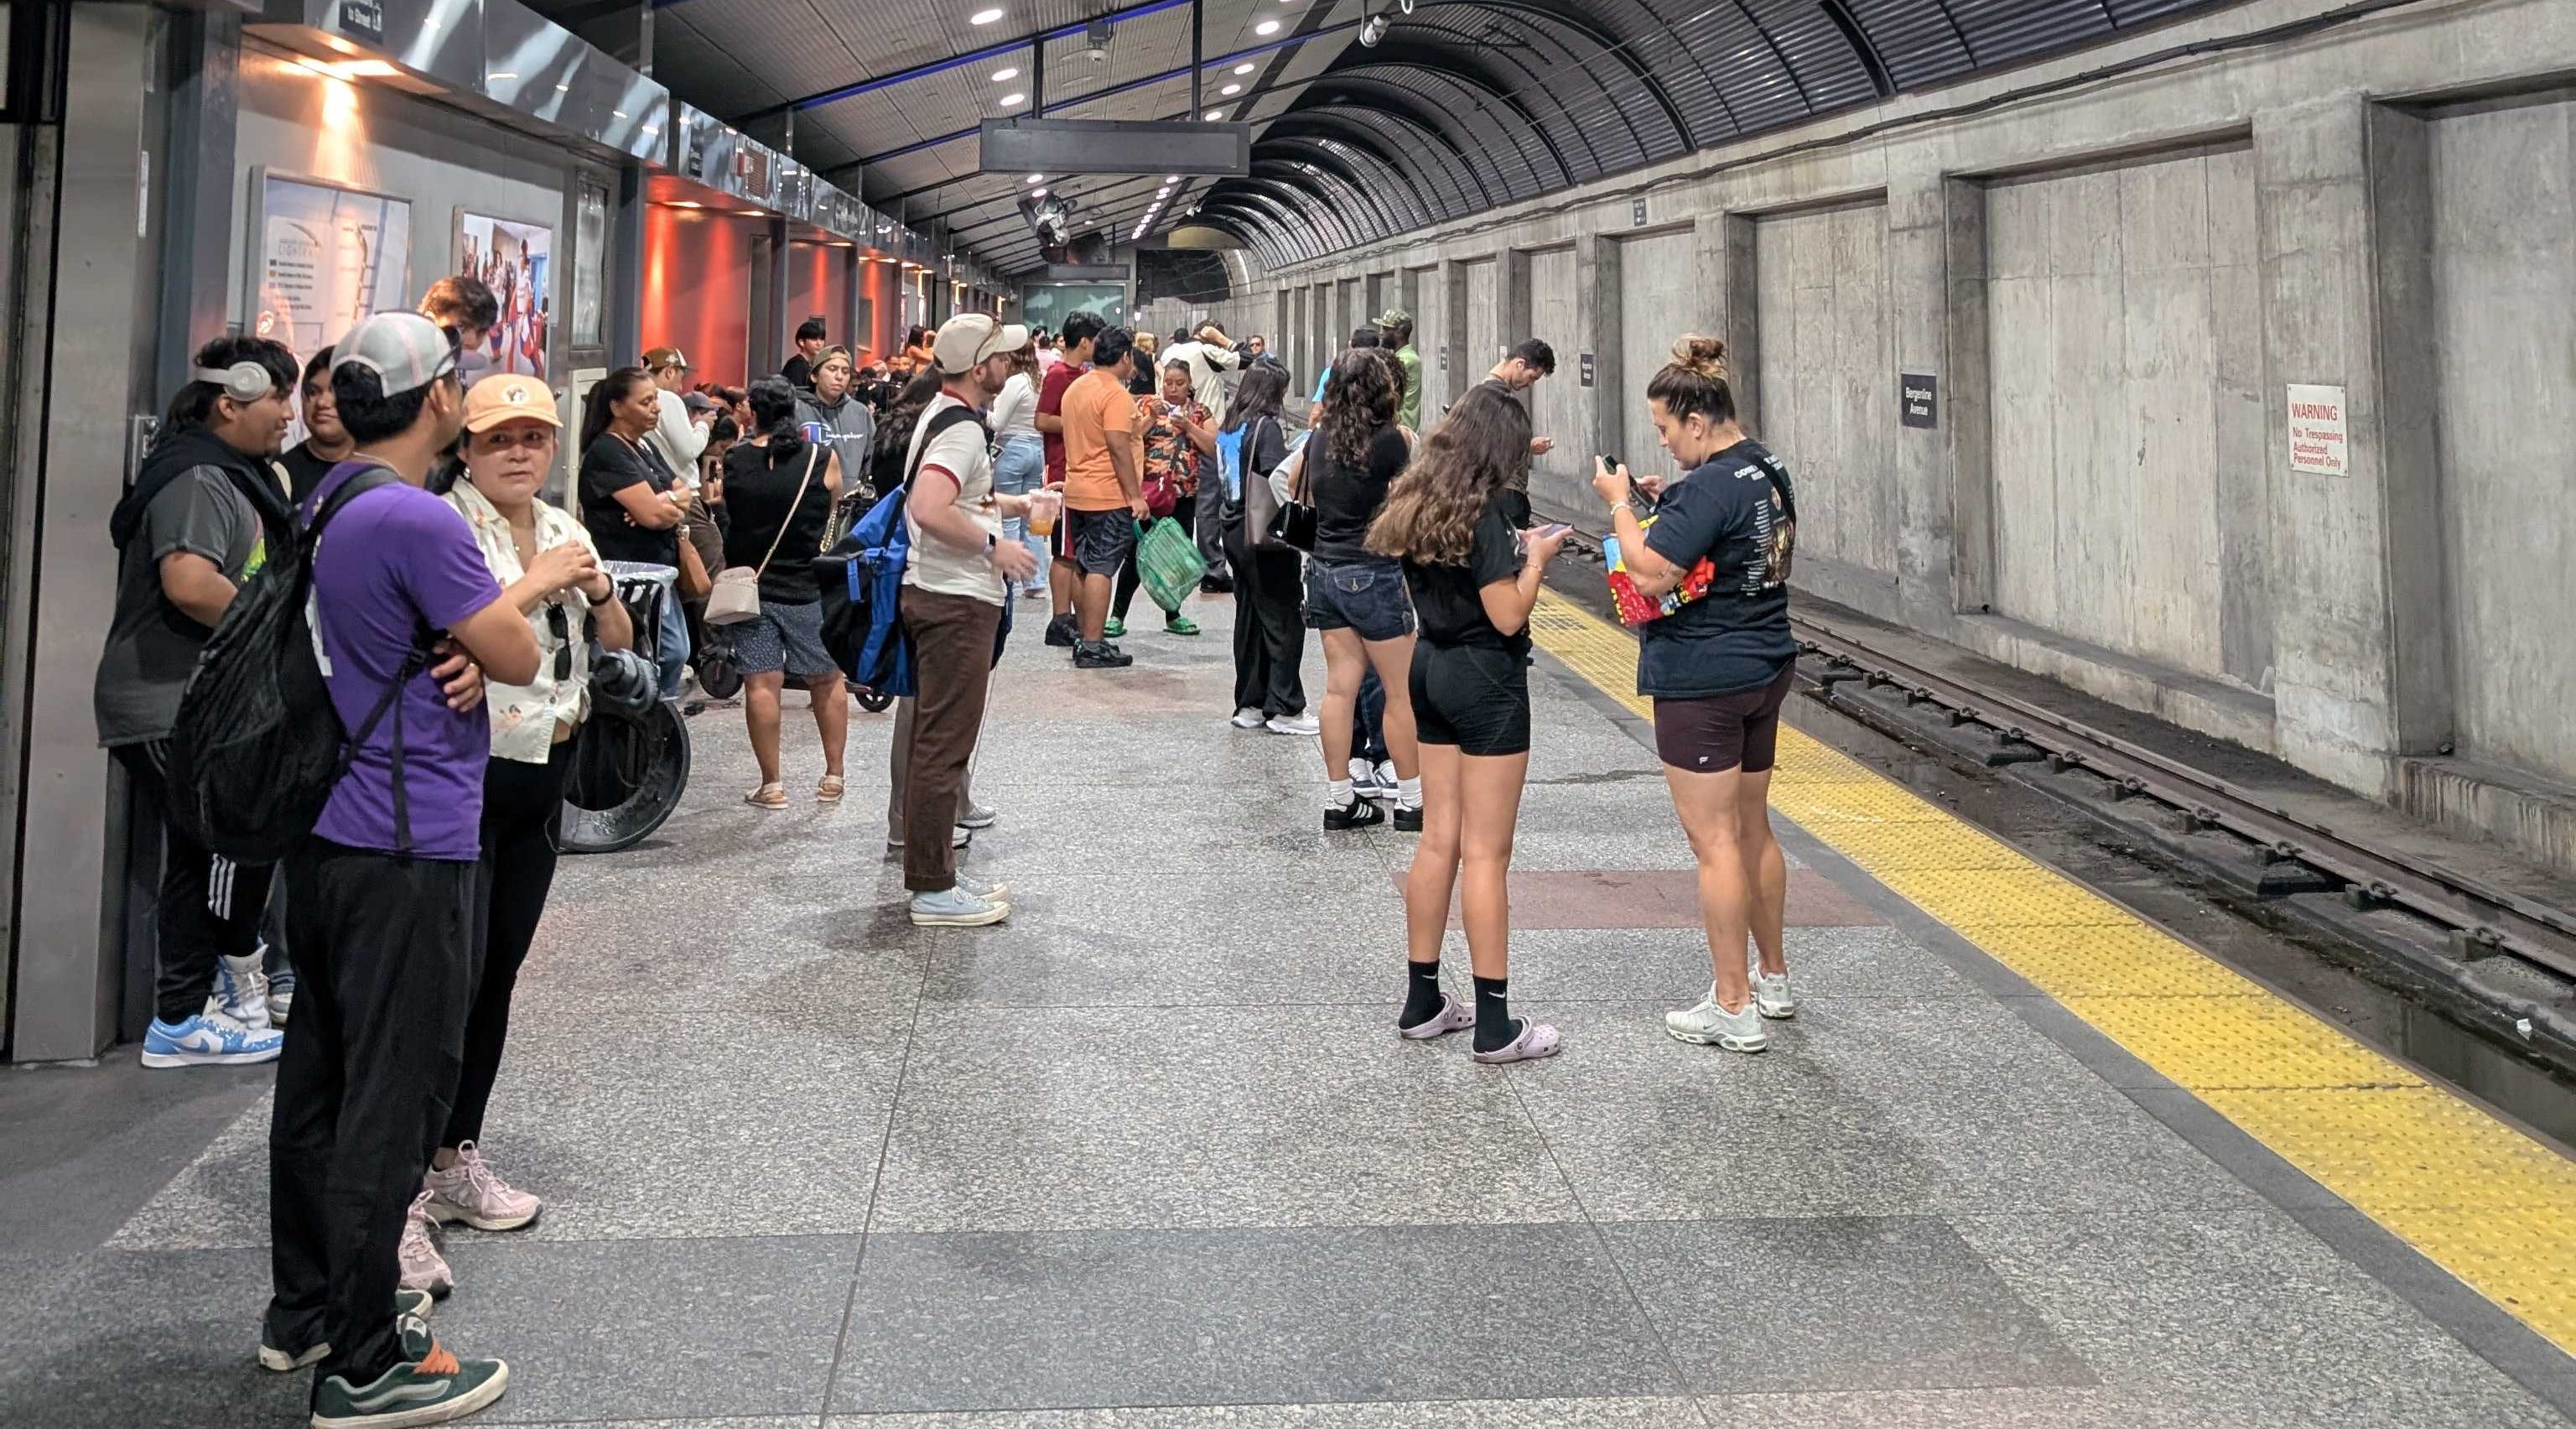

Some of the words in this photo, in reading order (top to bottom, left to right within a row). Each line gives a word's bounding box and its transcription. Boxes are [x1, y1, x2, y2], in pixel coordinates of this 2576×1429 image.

[1905, 387, 1932, 402] Bergenline
[1909, 403, 1929, 416] Avenue
[2292, 403, 2338, 421] WARNING
[2293, 427, 2303, 438] No
[2304, 428, 2343, 444] Trespassing
[2293, 441, 2328, 455] Authorized
[2293, 453, 2324, 465] Personnel
[2326, 456, 2341, 470] Only
